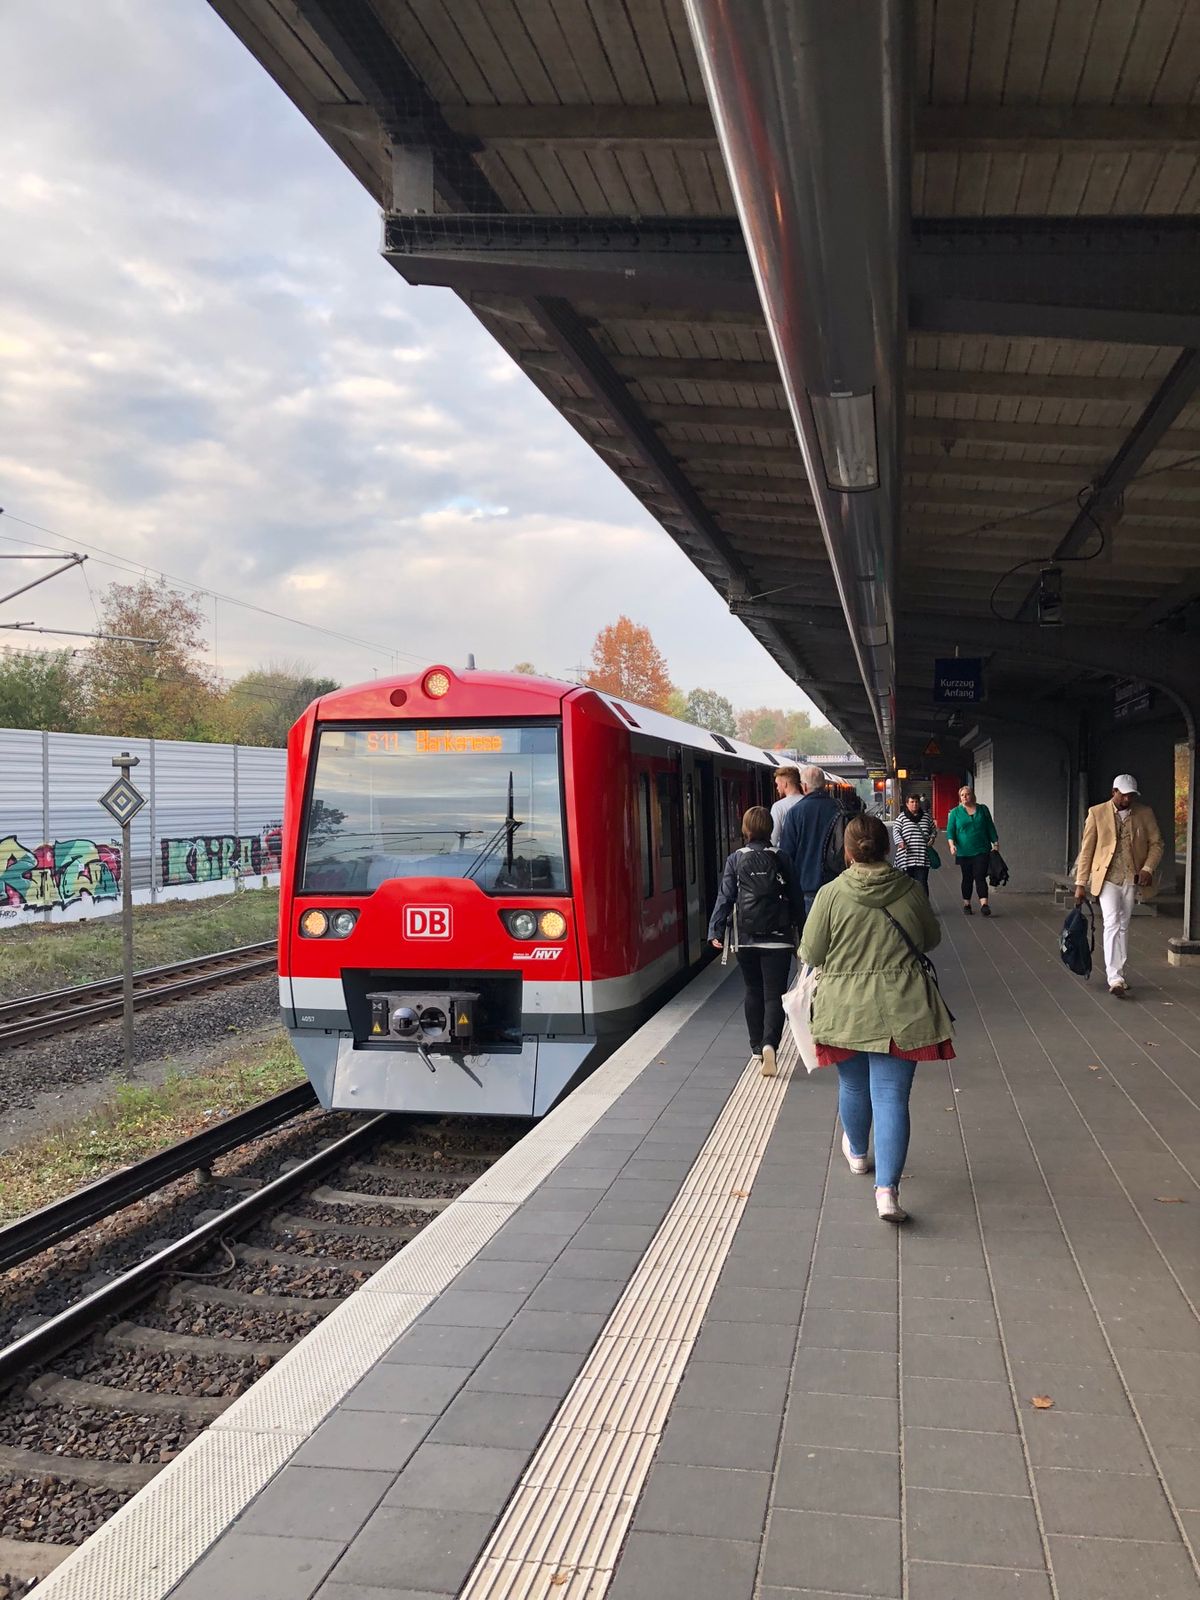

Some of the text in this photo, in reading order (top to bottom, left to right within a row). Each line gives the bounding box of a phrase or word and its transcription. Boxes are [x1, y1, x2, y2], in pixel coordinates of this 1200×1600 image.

[940, 679, 975, 689] Kurzzug
[944, 689, 975, 699] Anfang
[367, 732, 399, 752] S11
[409, 910, 447, 935] DB
